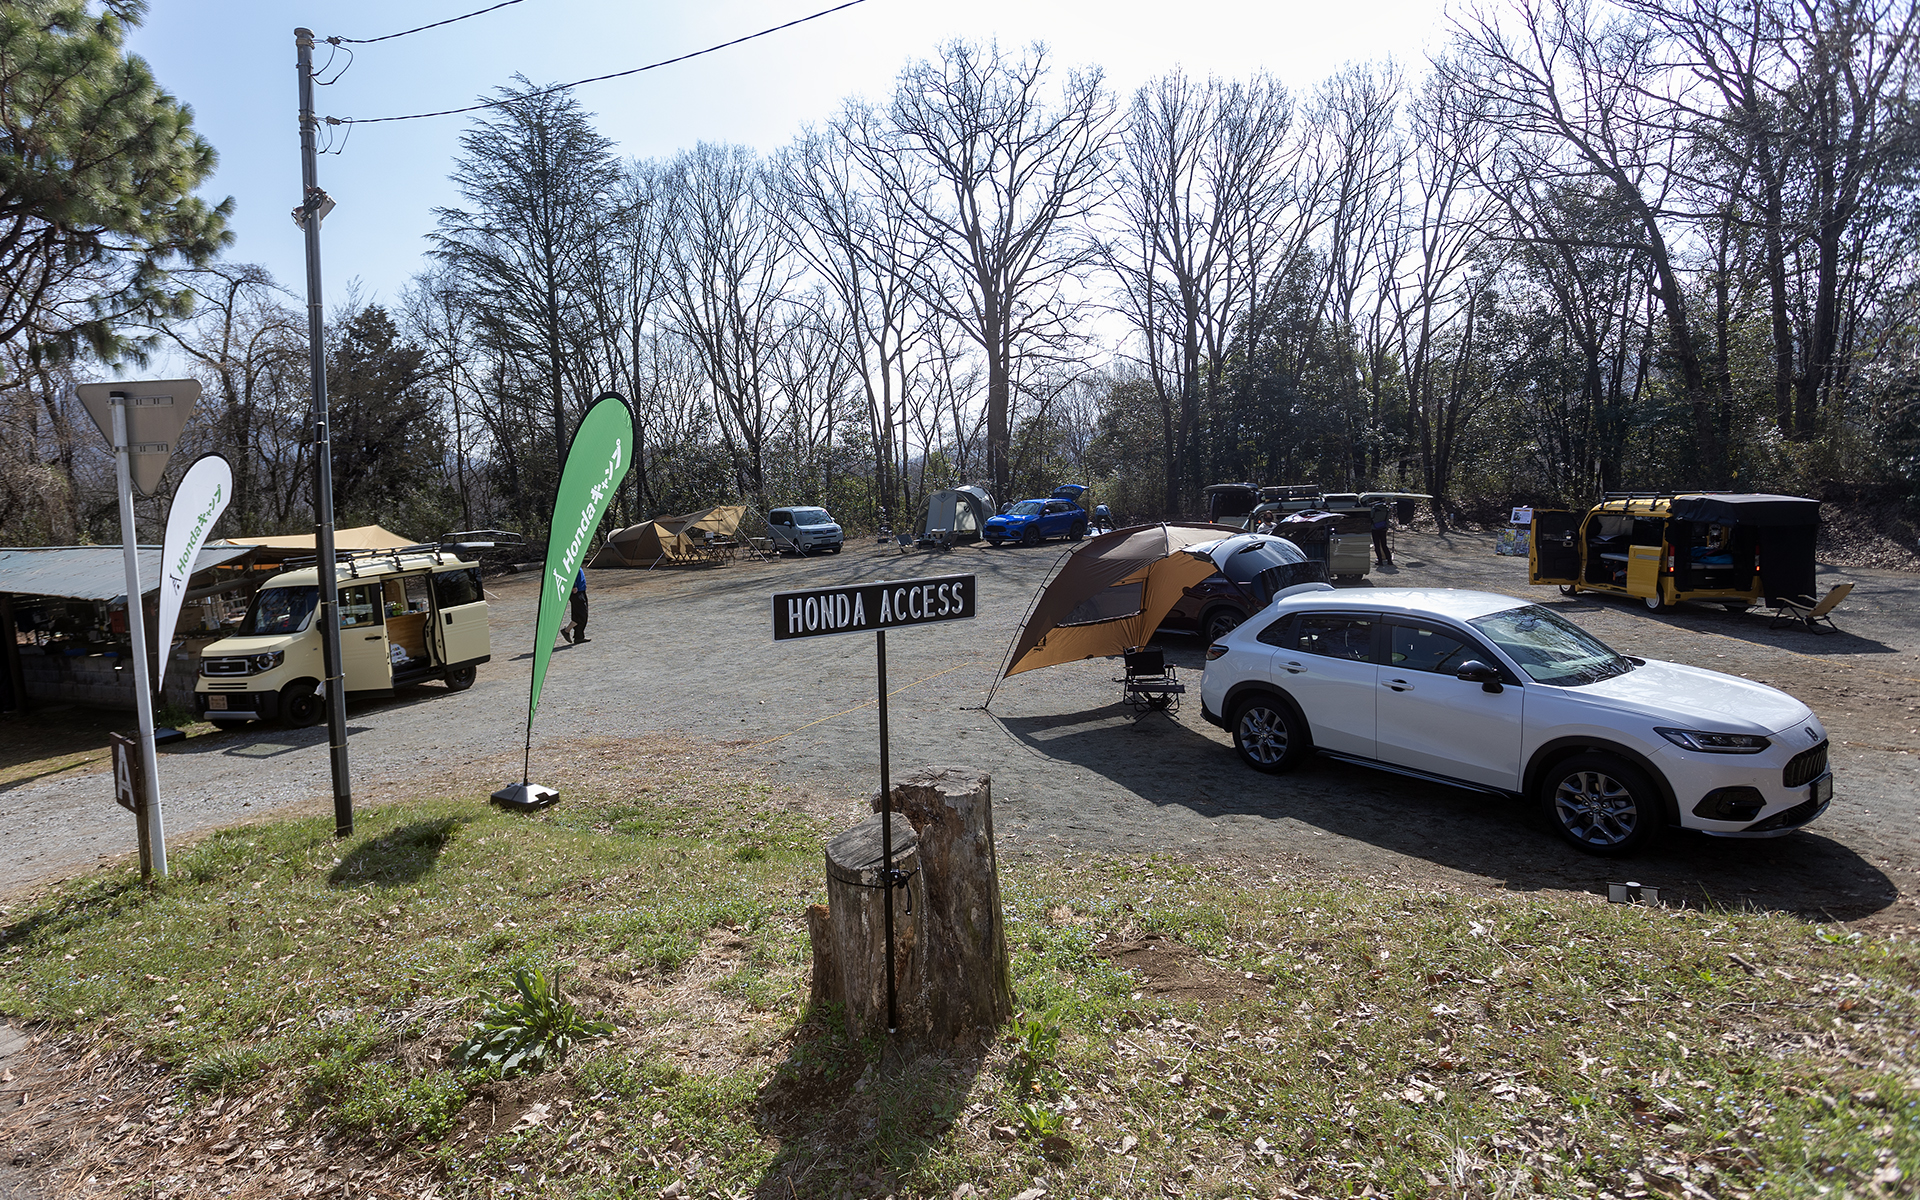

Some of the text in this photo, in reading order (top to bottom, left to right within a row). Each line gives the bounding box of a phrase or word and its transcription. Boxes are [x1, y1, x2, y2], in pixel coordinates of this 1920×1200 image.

[788, 581, 964, 634] HONDA ACCESS
[117, 743, 136, 808] A
